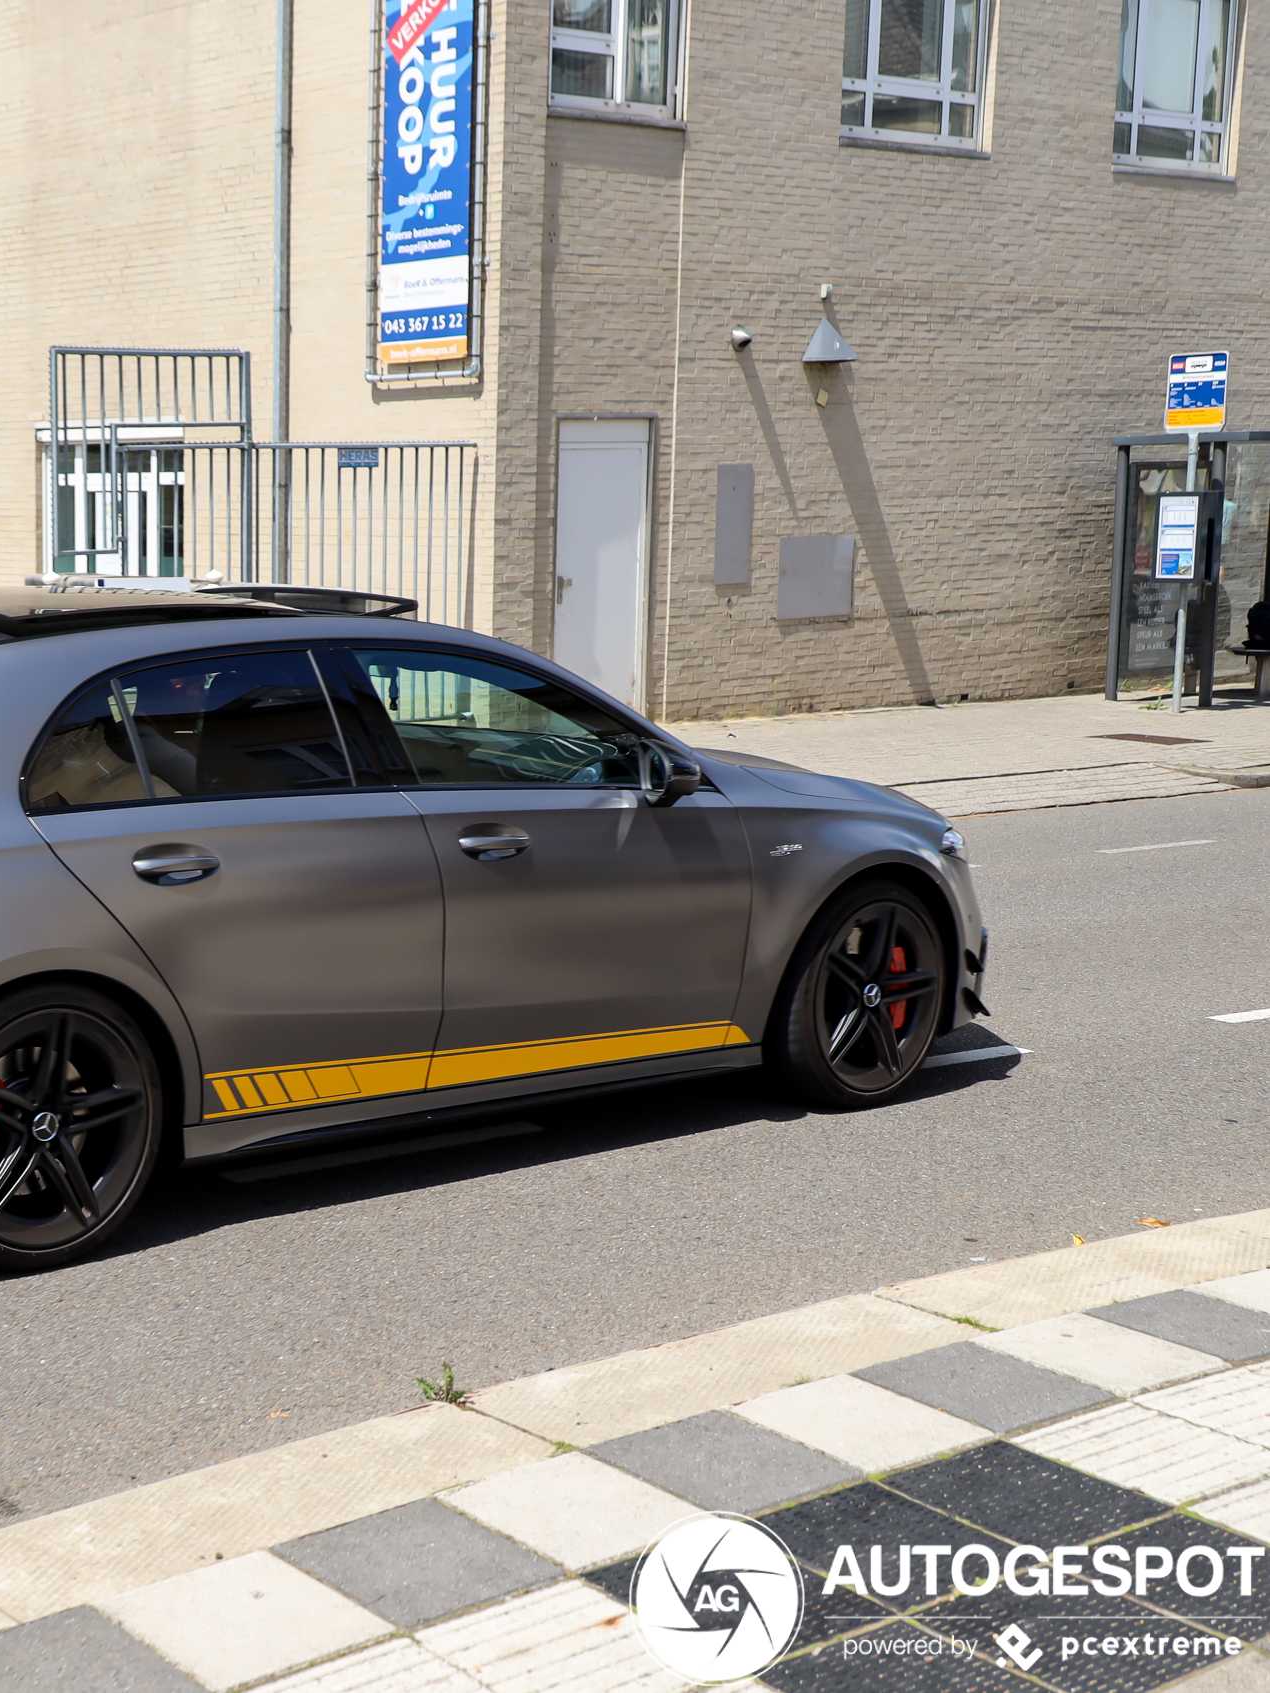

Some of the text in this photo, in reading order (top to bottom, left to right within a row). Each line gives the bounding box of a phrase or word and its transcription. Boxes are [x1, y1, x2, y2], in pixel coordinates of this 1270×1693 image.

[429, 26, 457, 170] HUUR
[384, 312, 463, 334] 043 367 15 22
[339, 450, 378, 461] HERAS
[1153, 605, 1164, 613] ALS
[1152, 630, 1163, 638] ALS
